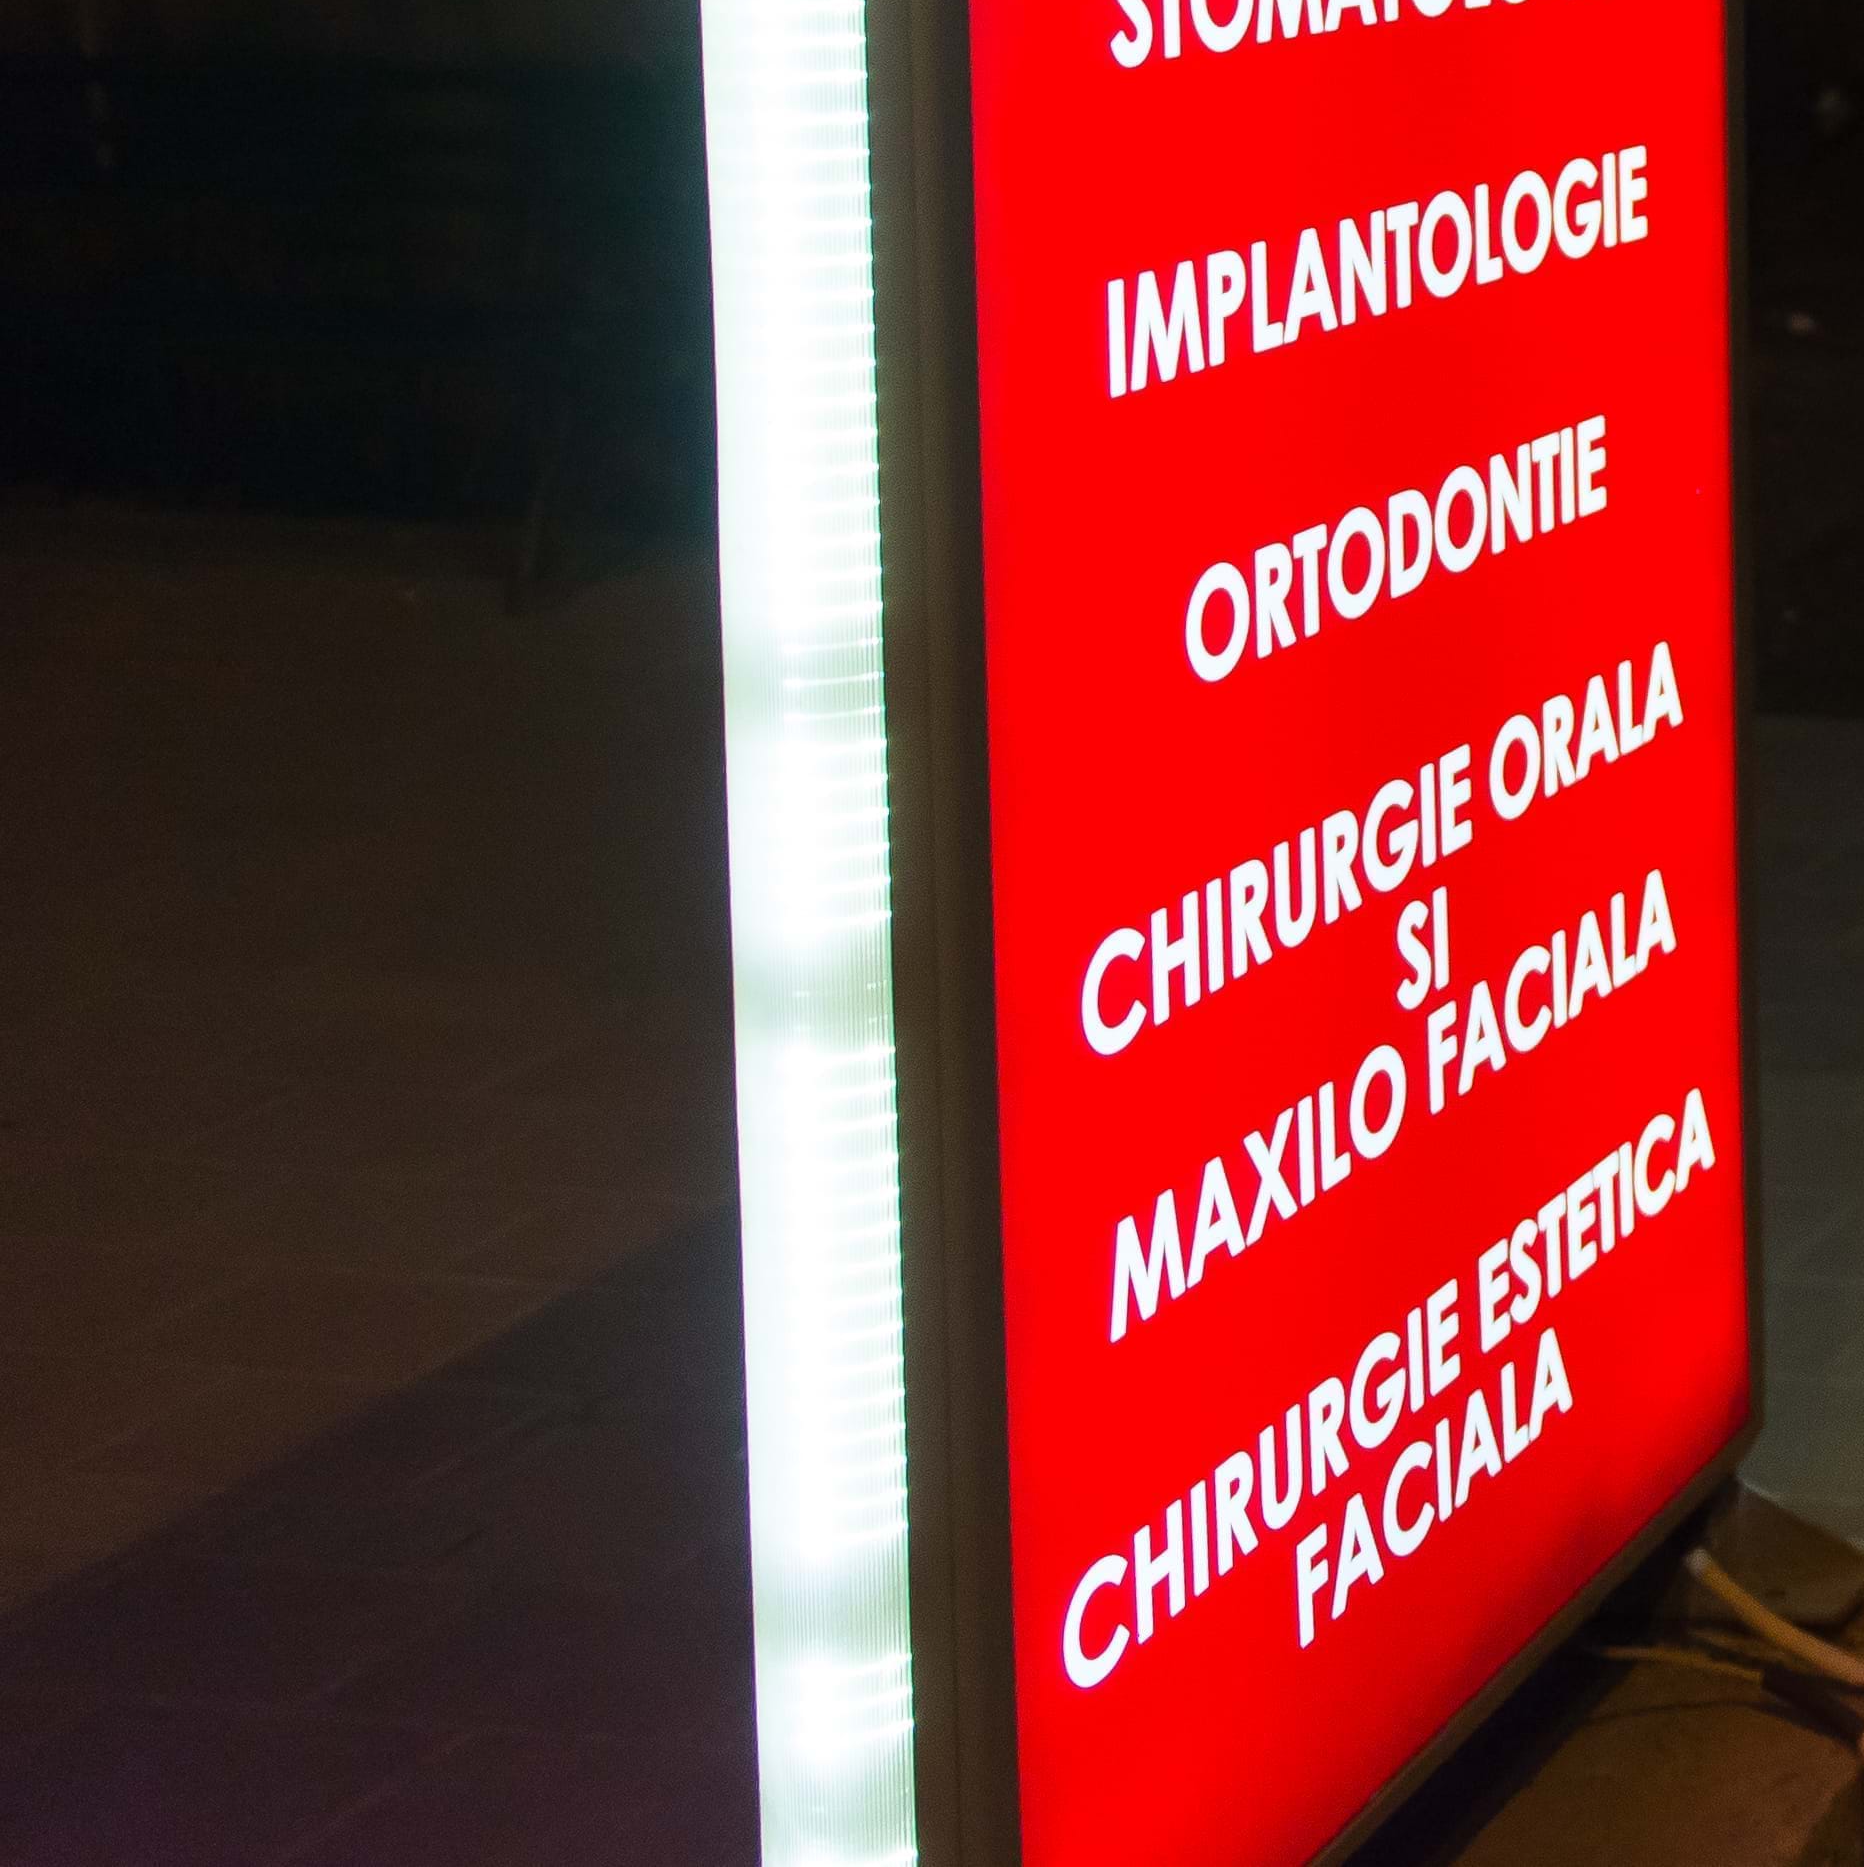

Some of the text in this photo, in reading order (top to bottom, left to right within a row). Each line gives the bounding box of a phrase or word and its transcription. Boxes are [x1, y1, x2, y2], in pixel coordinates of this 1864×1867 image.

[1106, 144, 1649, 398] IMPLANTOLOGIE
[1185, 415, 1607, 683] ORTODONTIE
[1080, 640, 1684, 1056] CHIRURGIE ORALA
[1396, 886, 1449, 1012] SI
[1108, 868, 1677, 1344] MAXILO FACIALA
[1061, 1088, 1716, 1689] CHIRURGIE ESTETICA
[1296, 1328, 1573, 1648] FACIALA
